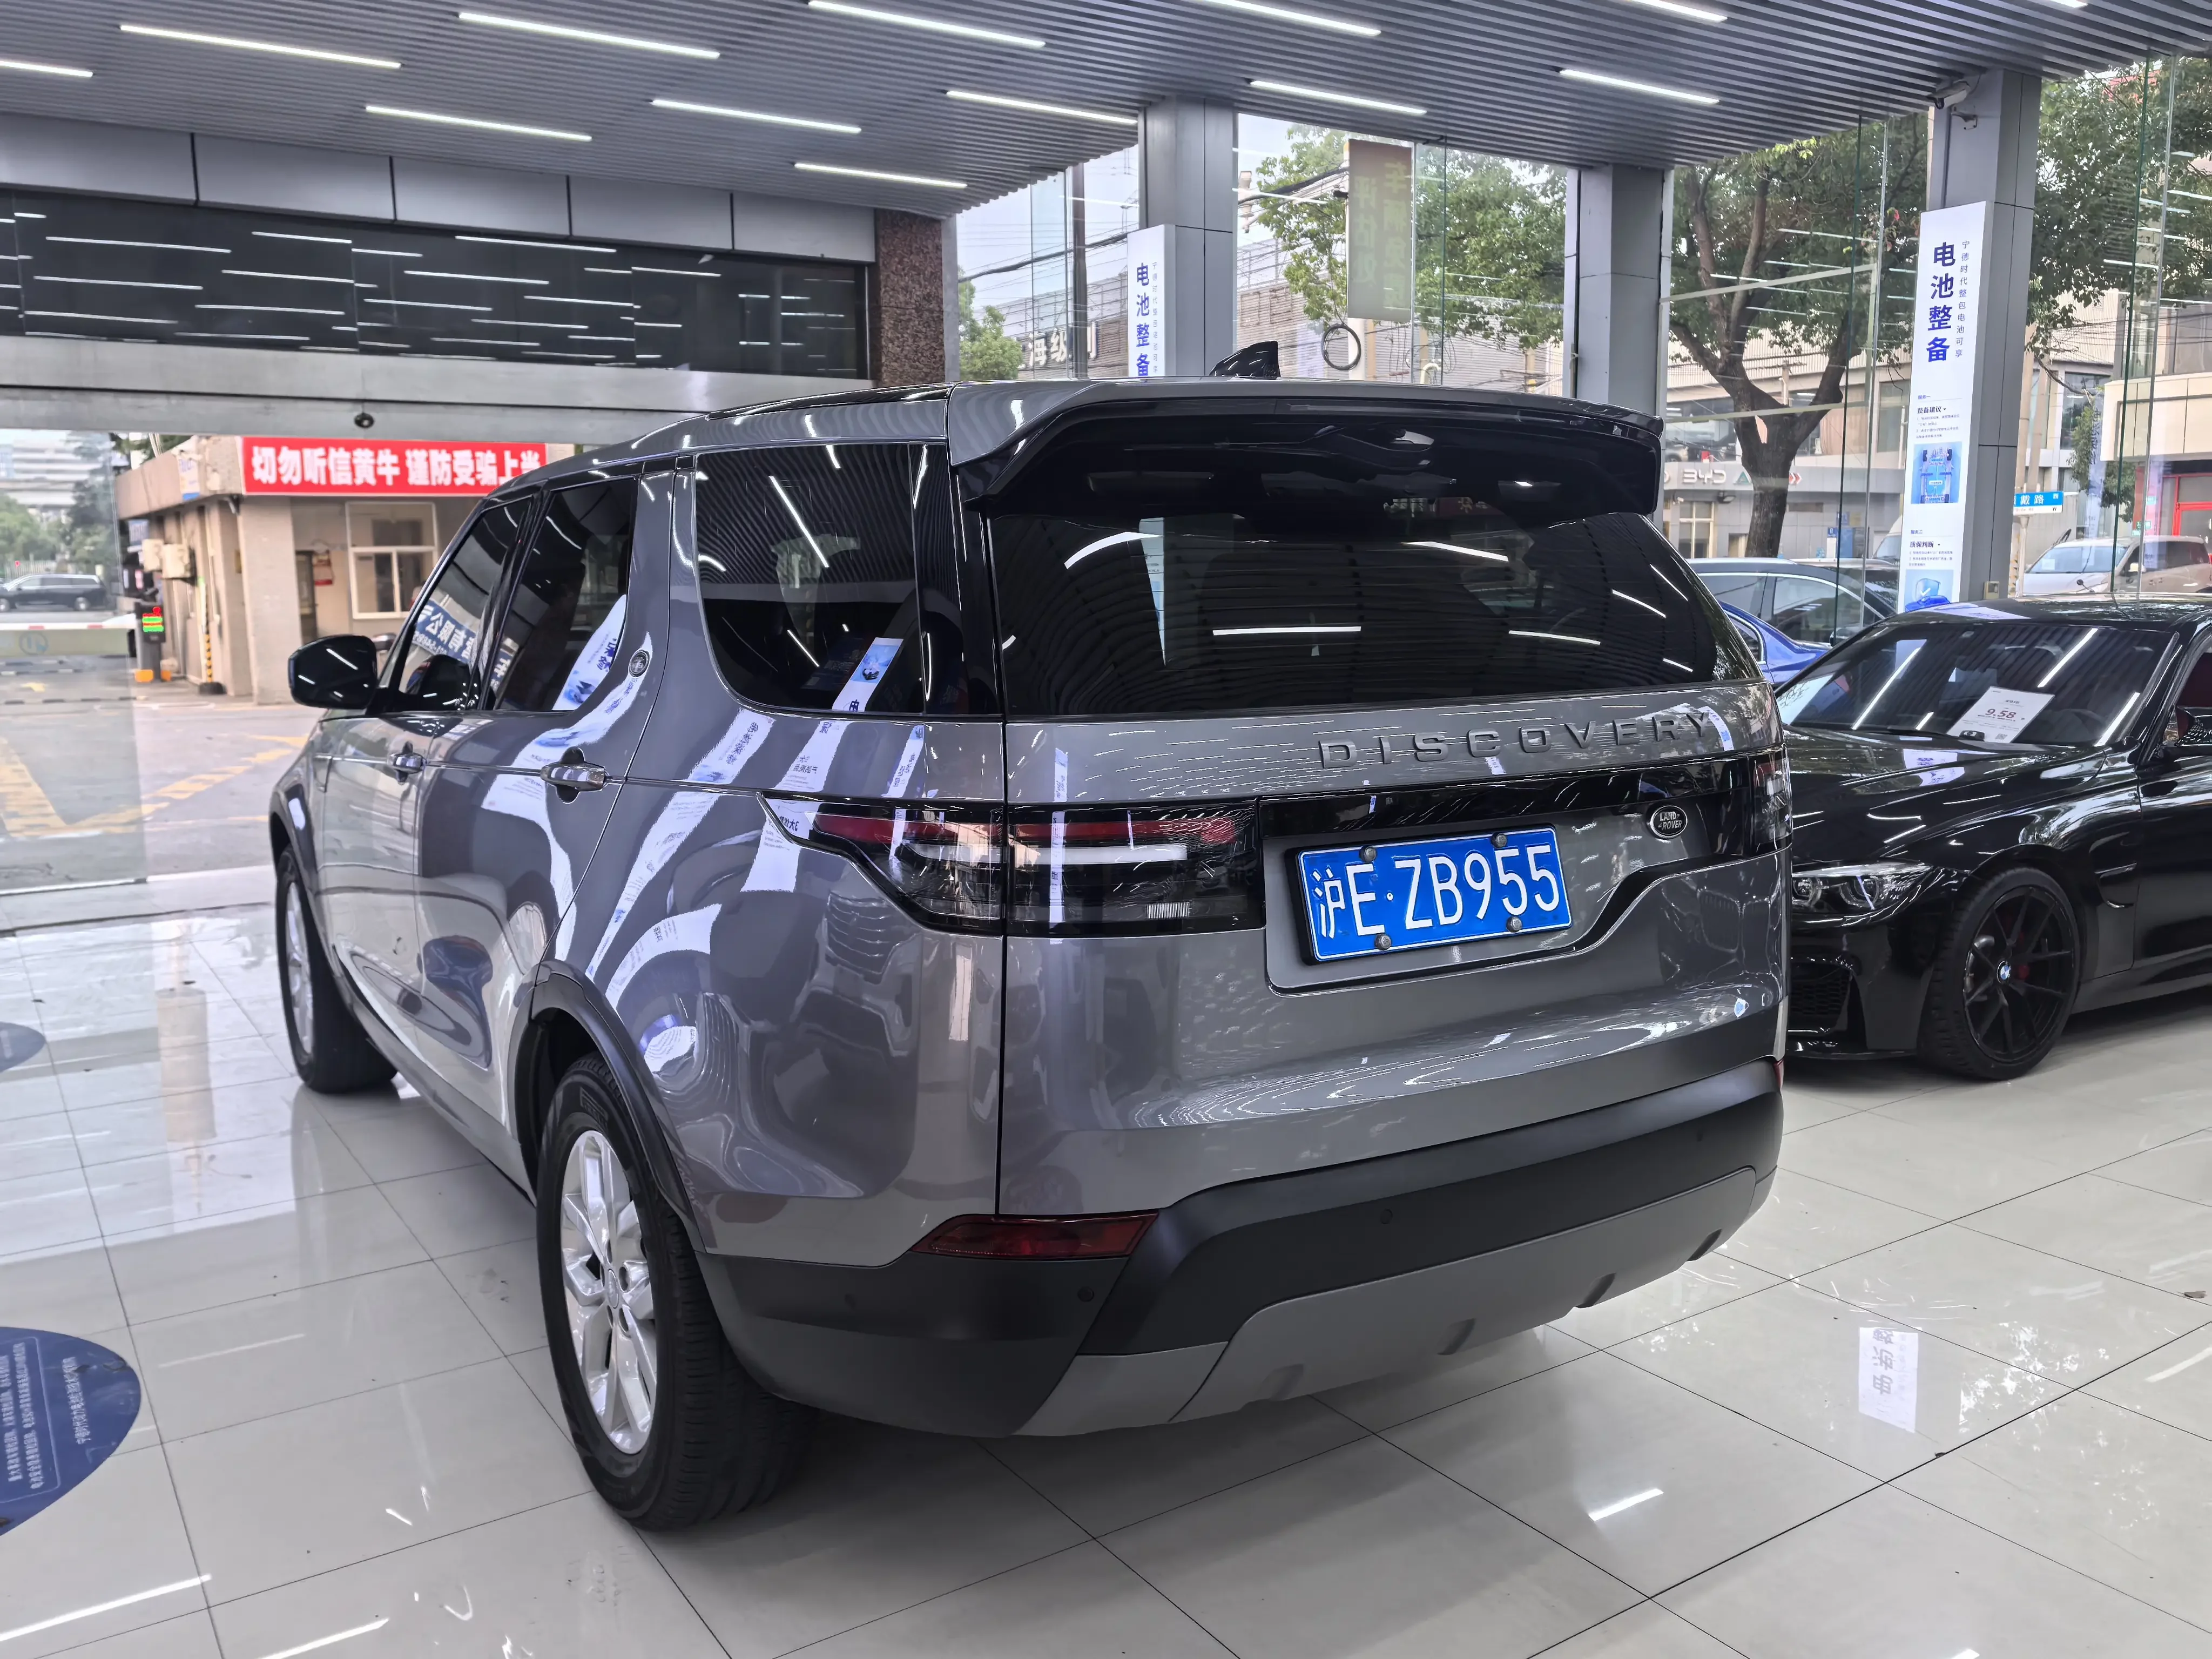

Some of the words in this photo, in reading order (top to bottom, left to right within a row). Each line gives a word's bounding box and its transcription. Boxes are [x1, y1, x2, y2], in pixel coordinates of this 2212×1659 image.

[1136, 262, 1150, 376] 电池整备
[1926, 242, 1955, 362] 电池整备
[1955, 240, 1970, 358] 宁德时代整包电池可享
[252, 446, 400, 485] 切勿听信黄牛
[406, 449, 541, 485] 谨防受骗上当
[1683, 469, 1727, 484] BYD
[1985, 709, 2017, 719] 9.58
[1318, 711, 1711, 768] DISCOVERY
[1660, 811, 1676, 821] LAND
[1662, 820, 1682, 830] ROVER
[1311, 845, 1560, 939] 沪E·ZB955
